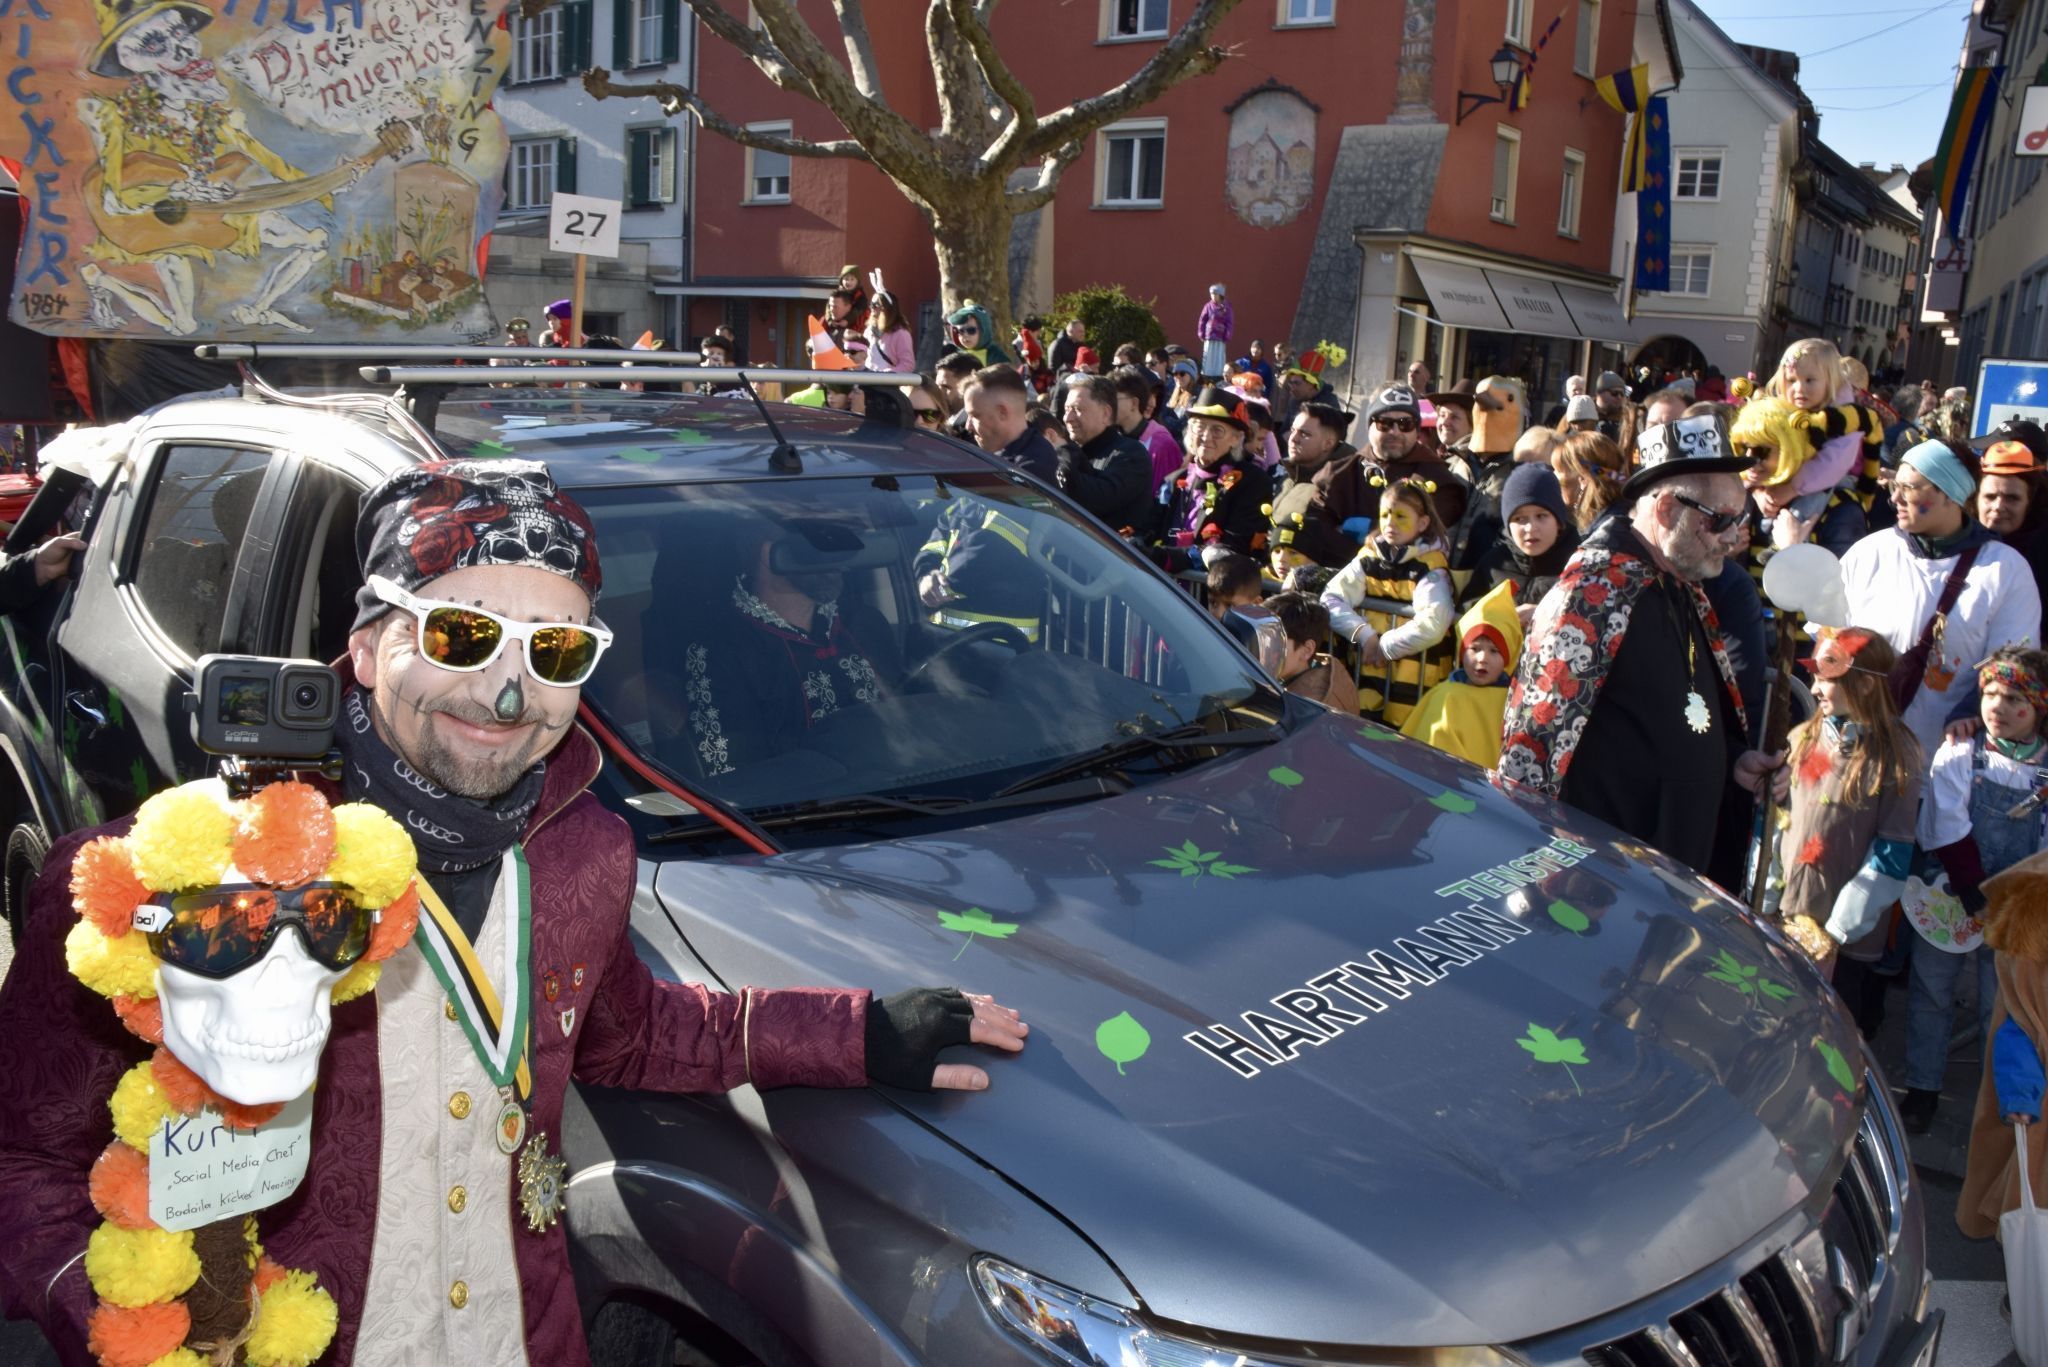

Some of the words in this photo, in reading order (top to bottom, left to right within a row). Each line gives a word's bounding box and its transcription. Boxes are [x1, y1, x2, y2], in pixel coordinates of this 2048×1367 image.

[565, 210, 607, 237] 27
[1183, 904, 1532, 1079] HARTMANN
[165, 1118, 257, 1158] Kur
[222, 1155, 260, 1175] Media
